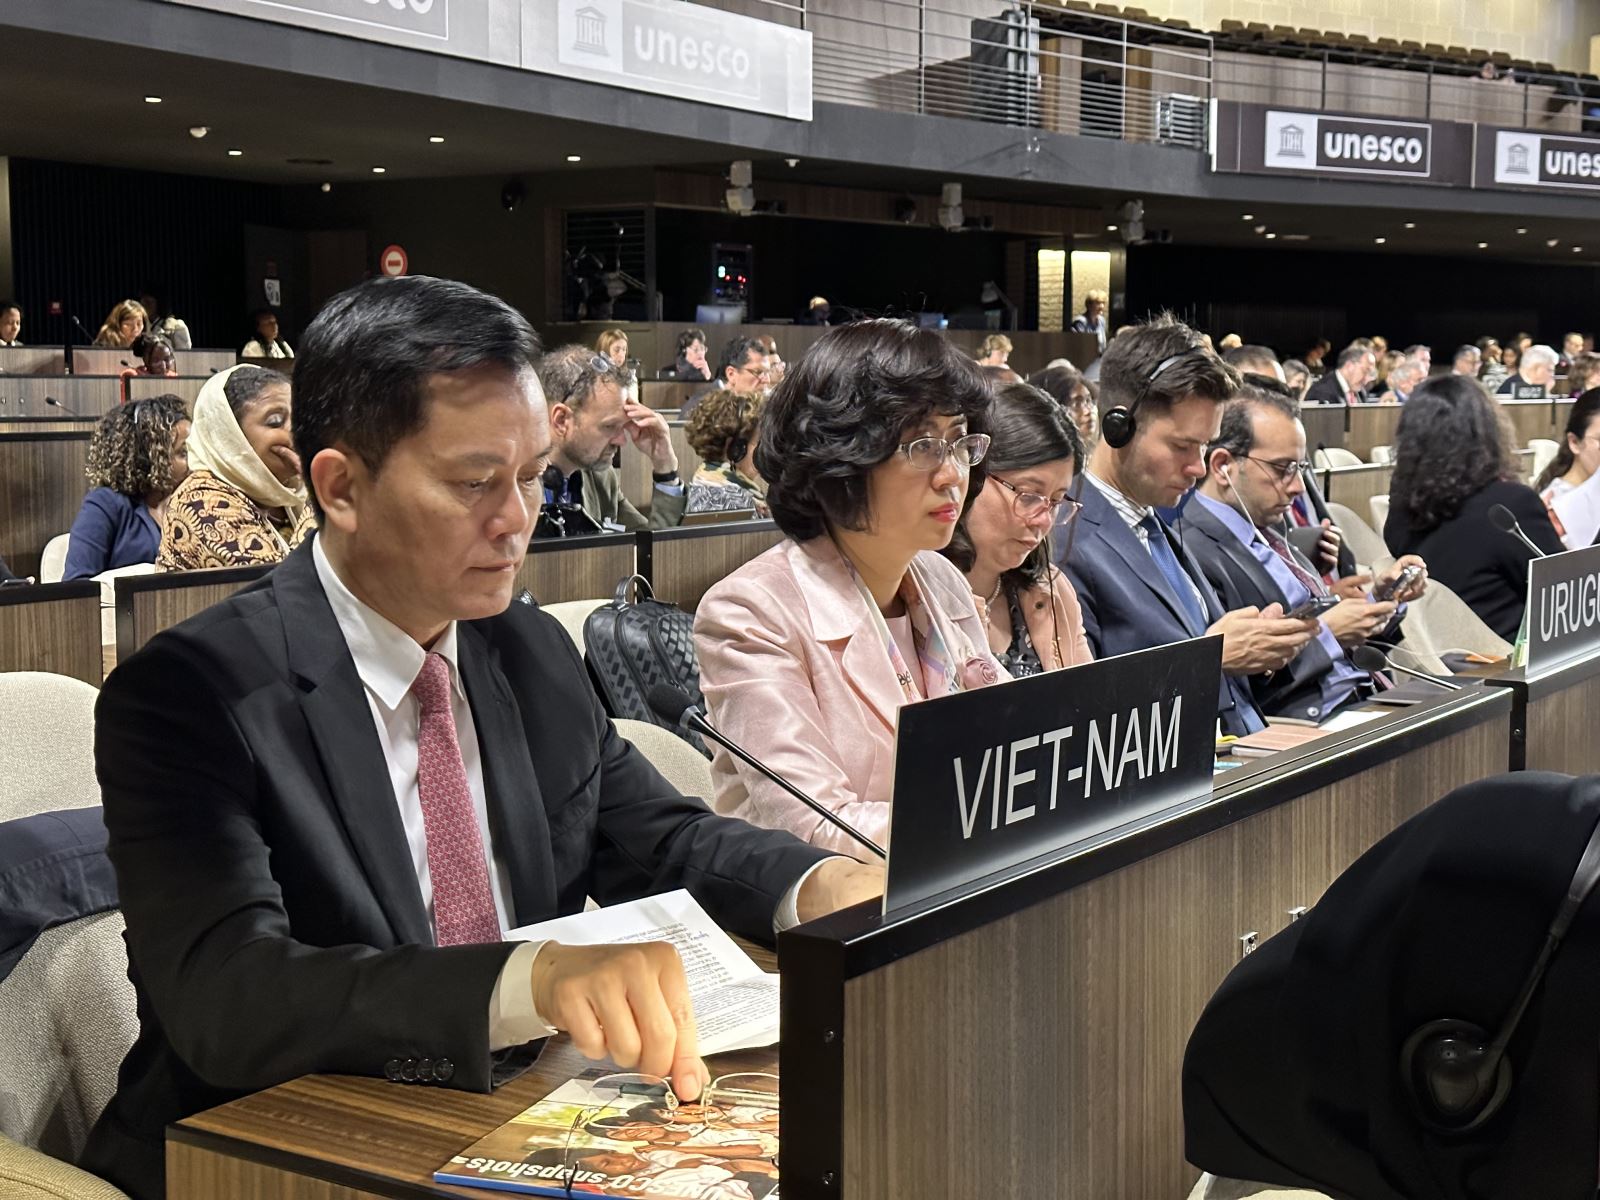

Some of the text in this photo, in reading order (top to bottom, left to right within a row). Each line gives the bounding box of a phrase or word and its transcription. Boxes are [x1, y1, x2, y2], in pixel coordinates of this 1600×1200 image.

[634, 24, 750, 79] unesco
[1324, 132, 1423, 164] unesco
[1540, 572, 1600, 642] URUG
[953, 695, 1182, 839] VIET-NAM
[466, 1157, 608, 1184] snapshots
